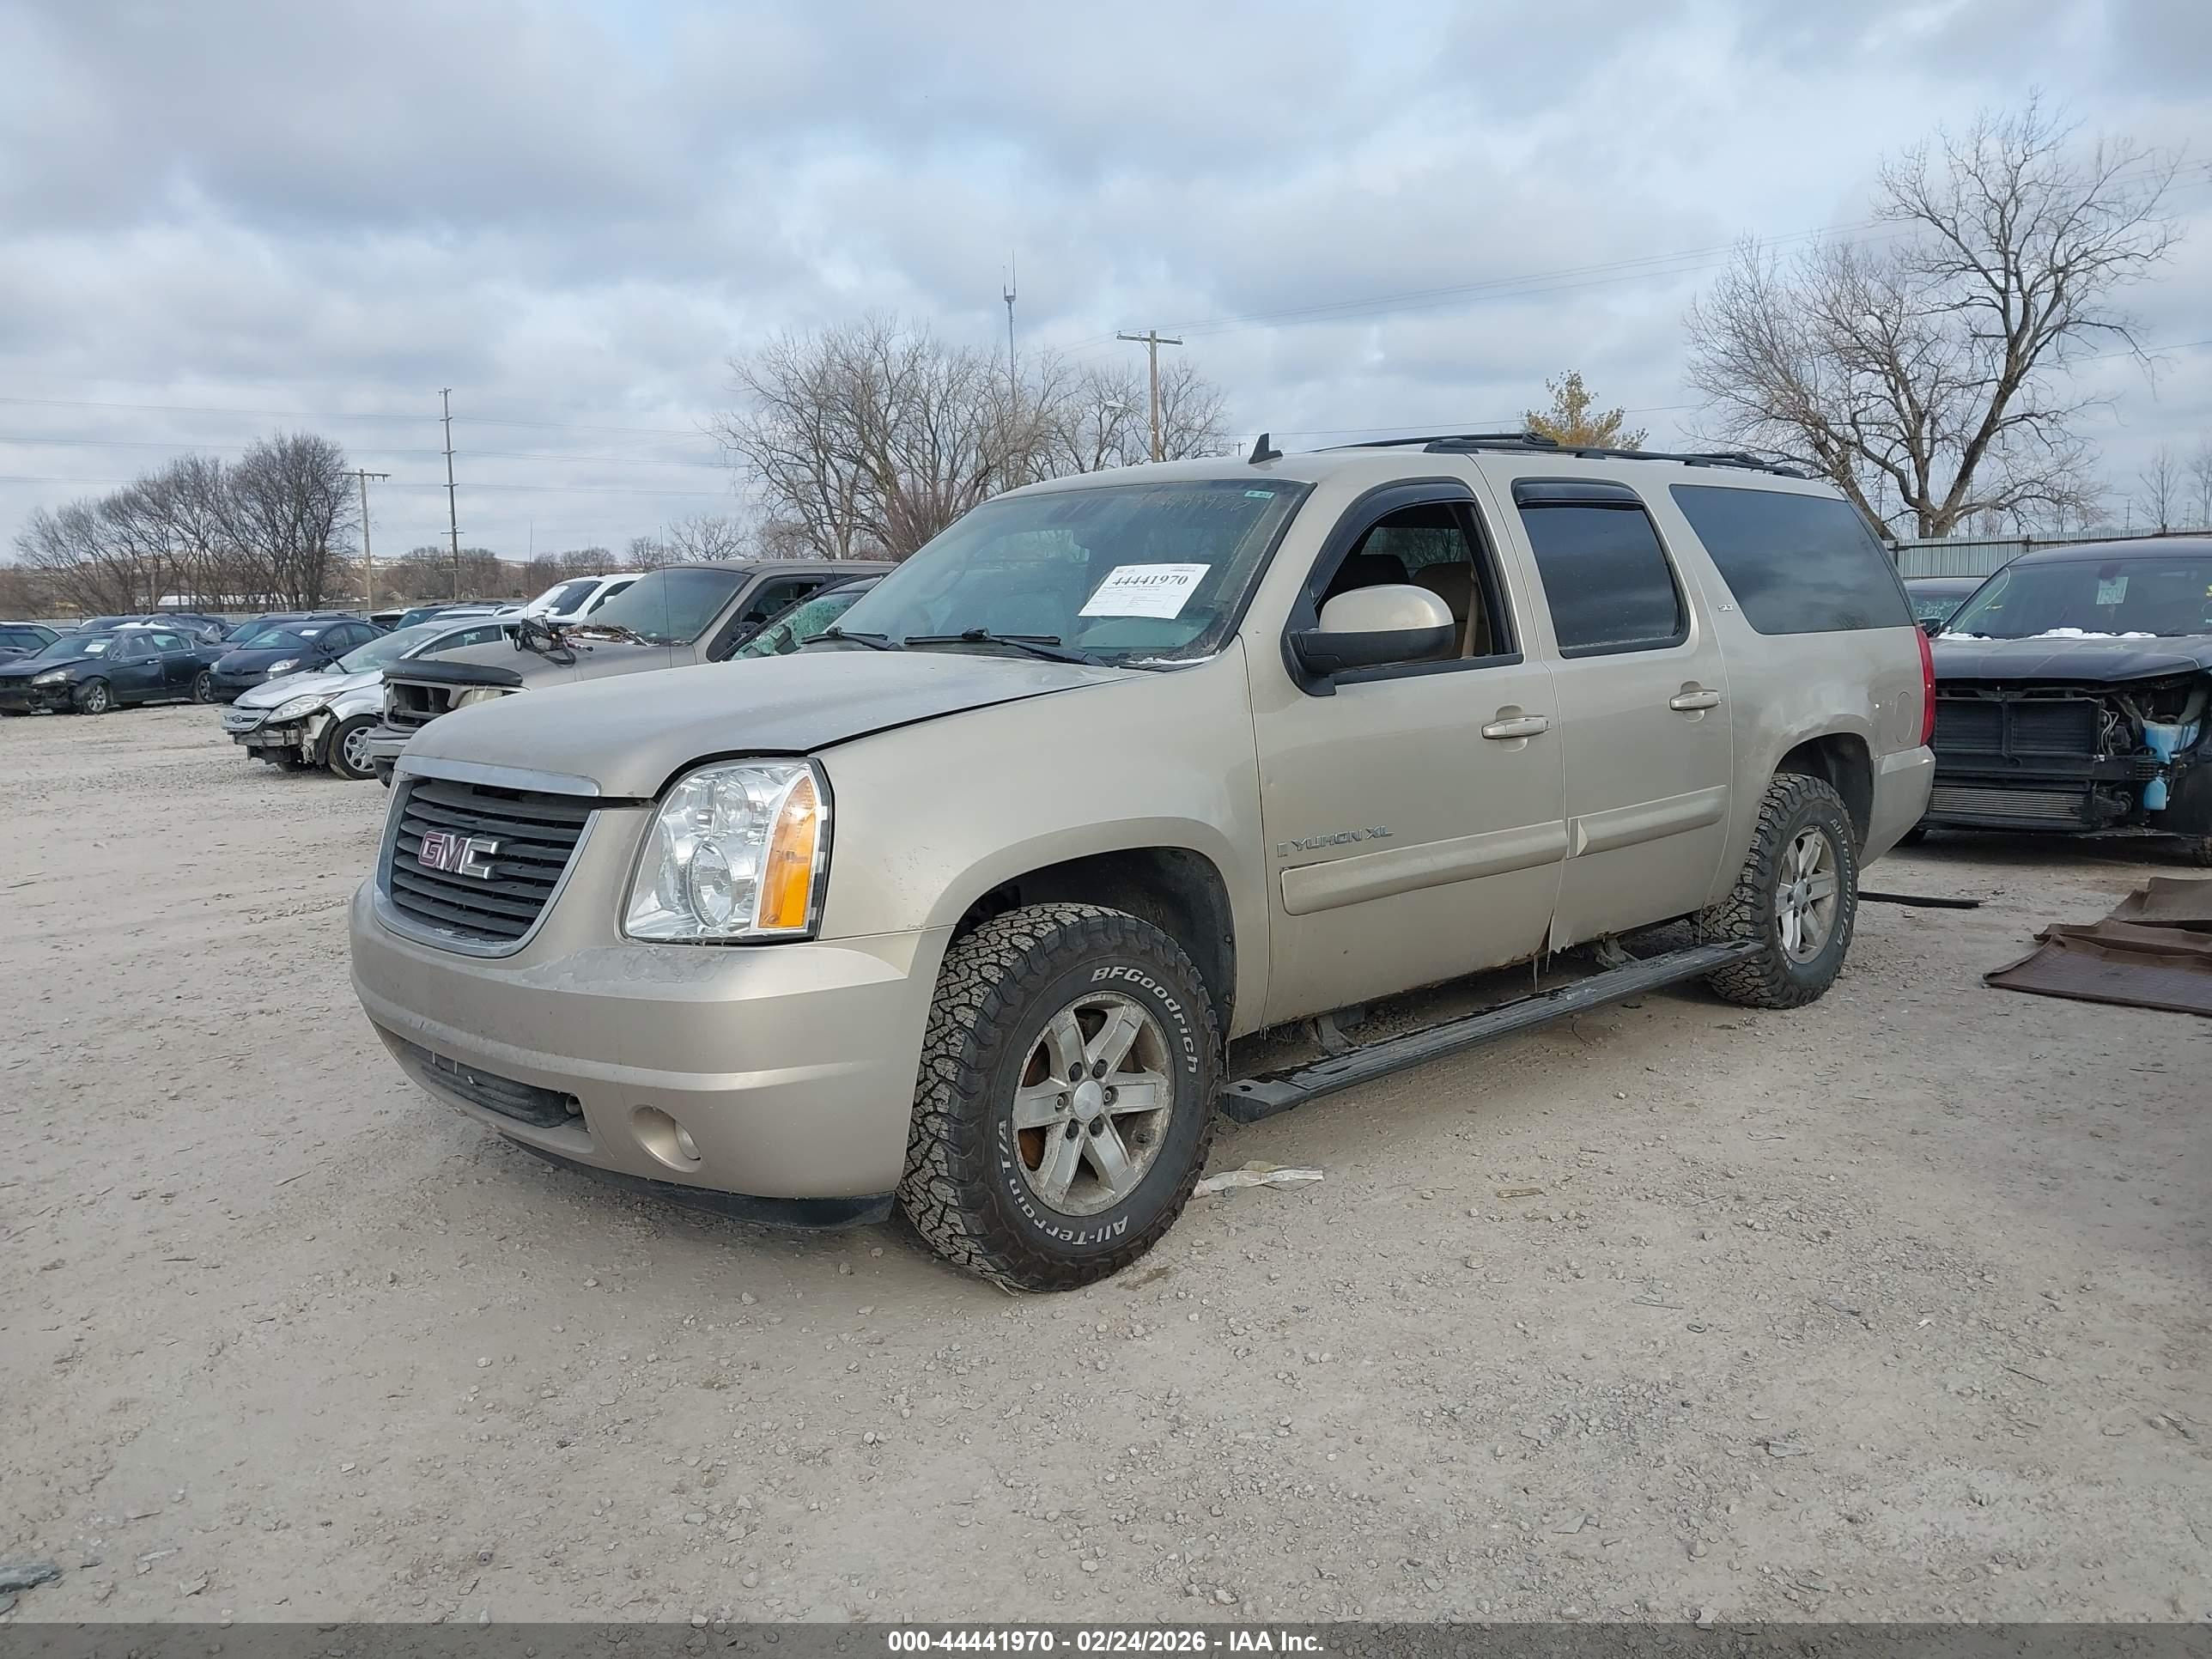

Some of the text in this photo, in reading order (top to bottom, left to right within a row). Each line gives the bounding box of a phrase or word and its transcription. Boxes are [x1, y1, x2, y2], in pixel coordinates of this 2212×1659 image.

[1112, 574, 1188, 586] 44441970
[418, 830, 499, 880] GMC
[1365, 825, 1395, 840] XL
[1829, 818, 1853, 913] All-Terrain
[1090, 966, 1199, 1073] BFGoodrich
[998, 1120, 1129, 1245] All-Terrain T/A
